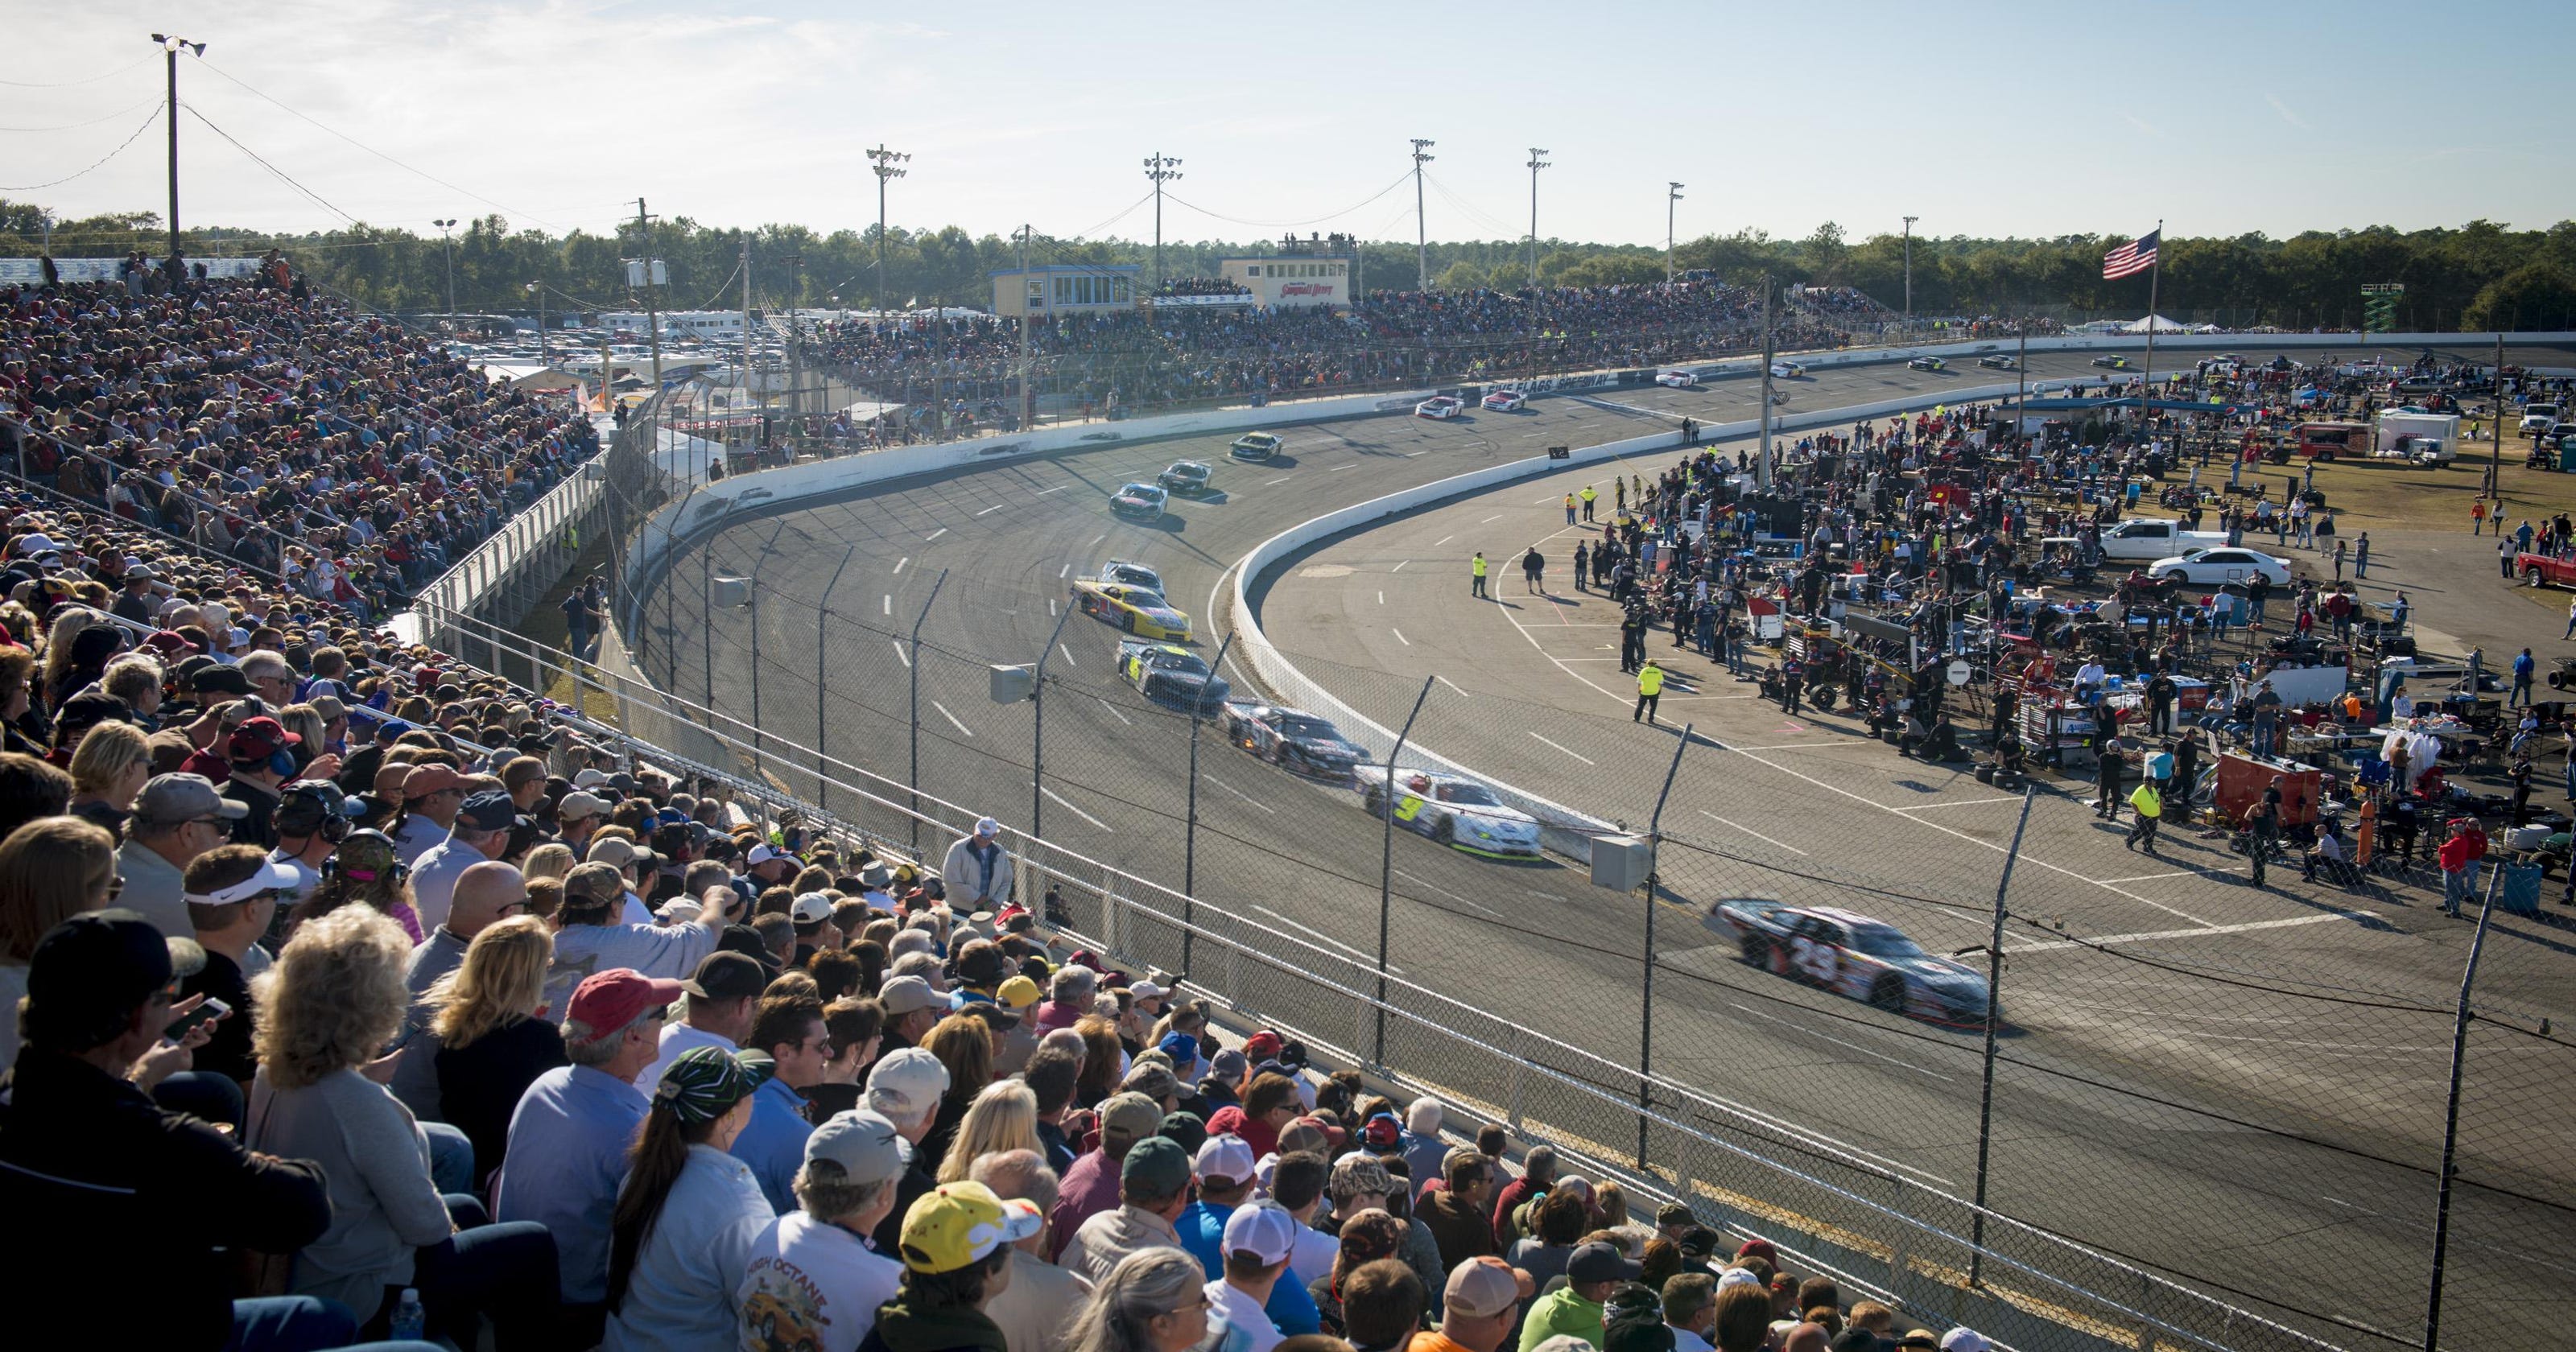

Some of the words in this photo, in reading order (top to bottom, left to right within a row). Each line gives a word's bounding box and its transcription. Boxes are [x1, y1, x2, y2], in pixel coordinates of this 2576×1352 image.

[1516, 380, 1552, 394] FLAGS
[1557, 374, 1608, 390] SPEEDWAY
[774, 1258, 828, 1309] OCTANE
